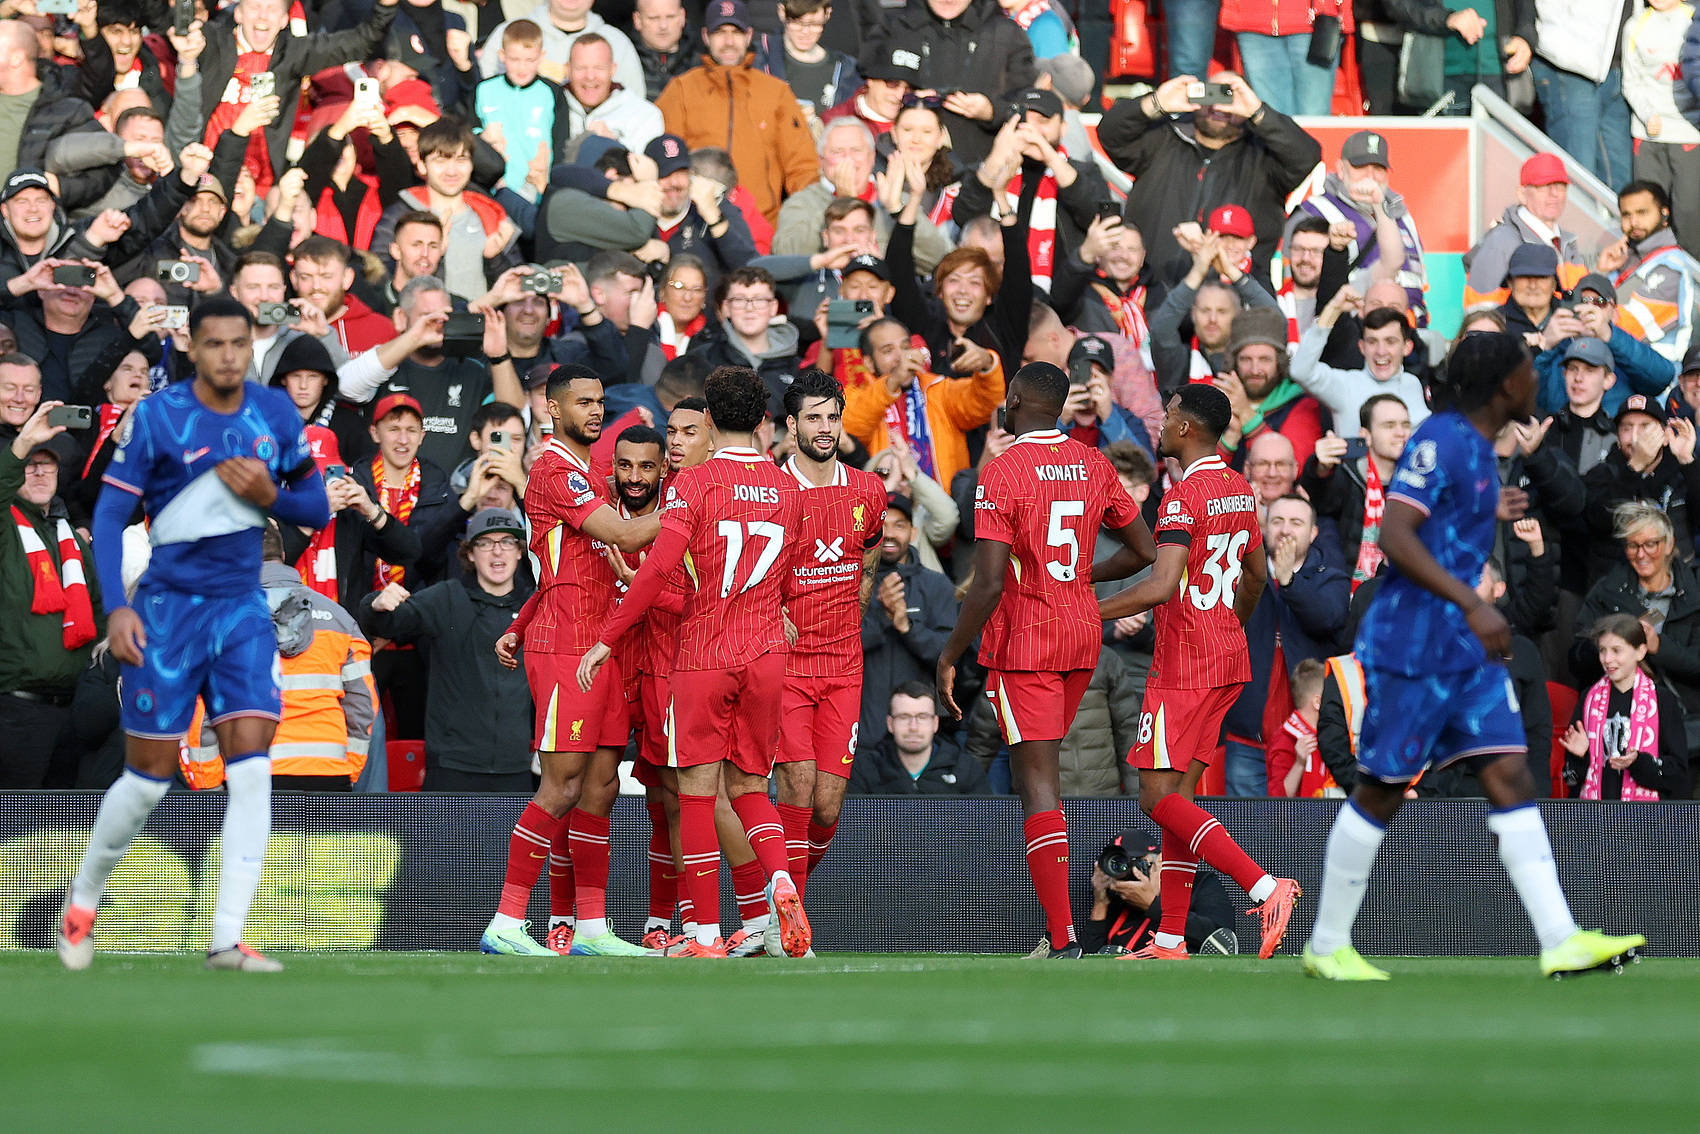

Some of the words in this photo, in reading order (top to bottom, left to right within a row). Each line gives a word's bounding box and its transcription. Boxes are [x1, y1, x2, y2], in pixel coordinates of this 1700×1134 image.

[1035, 459, 1089, 482] KONATÉ
[665, 498, 688, 511] edia
[733, 484, 780, 504] JONES
[486, 515, 512, 528] UFC
[1046, 500, 1085, 582] 5
[718, 519, 786, 599] 17
[1188, 529, 1251, 611] 38
[848, 721, 860, 755] 8
